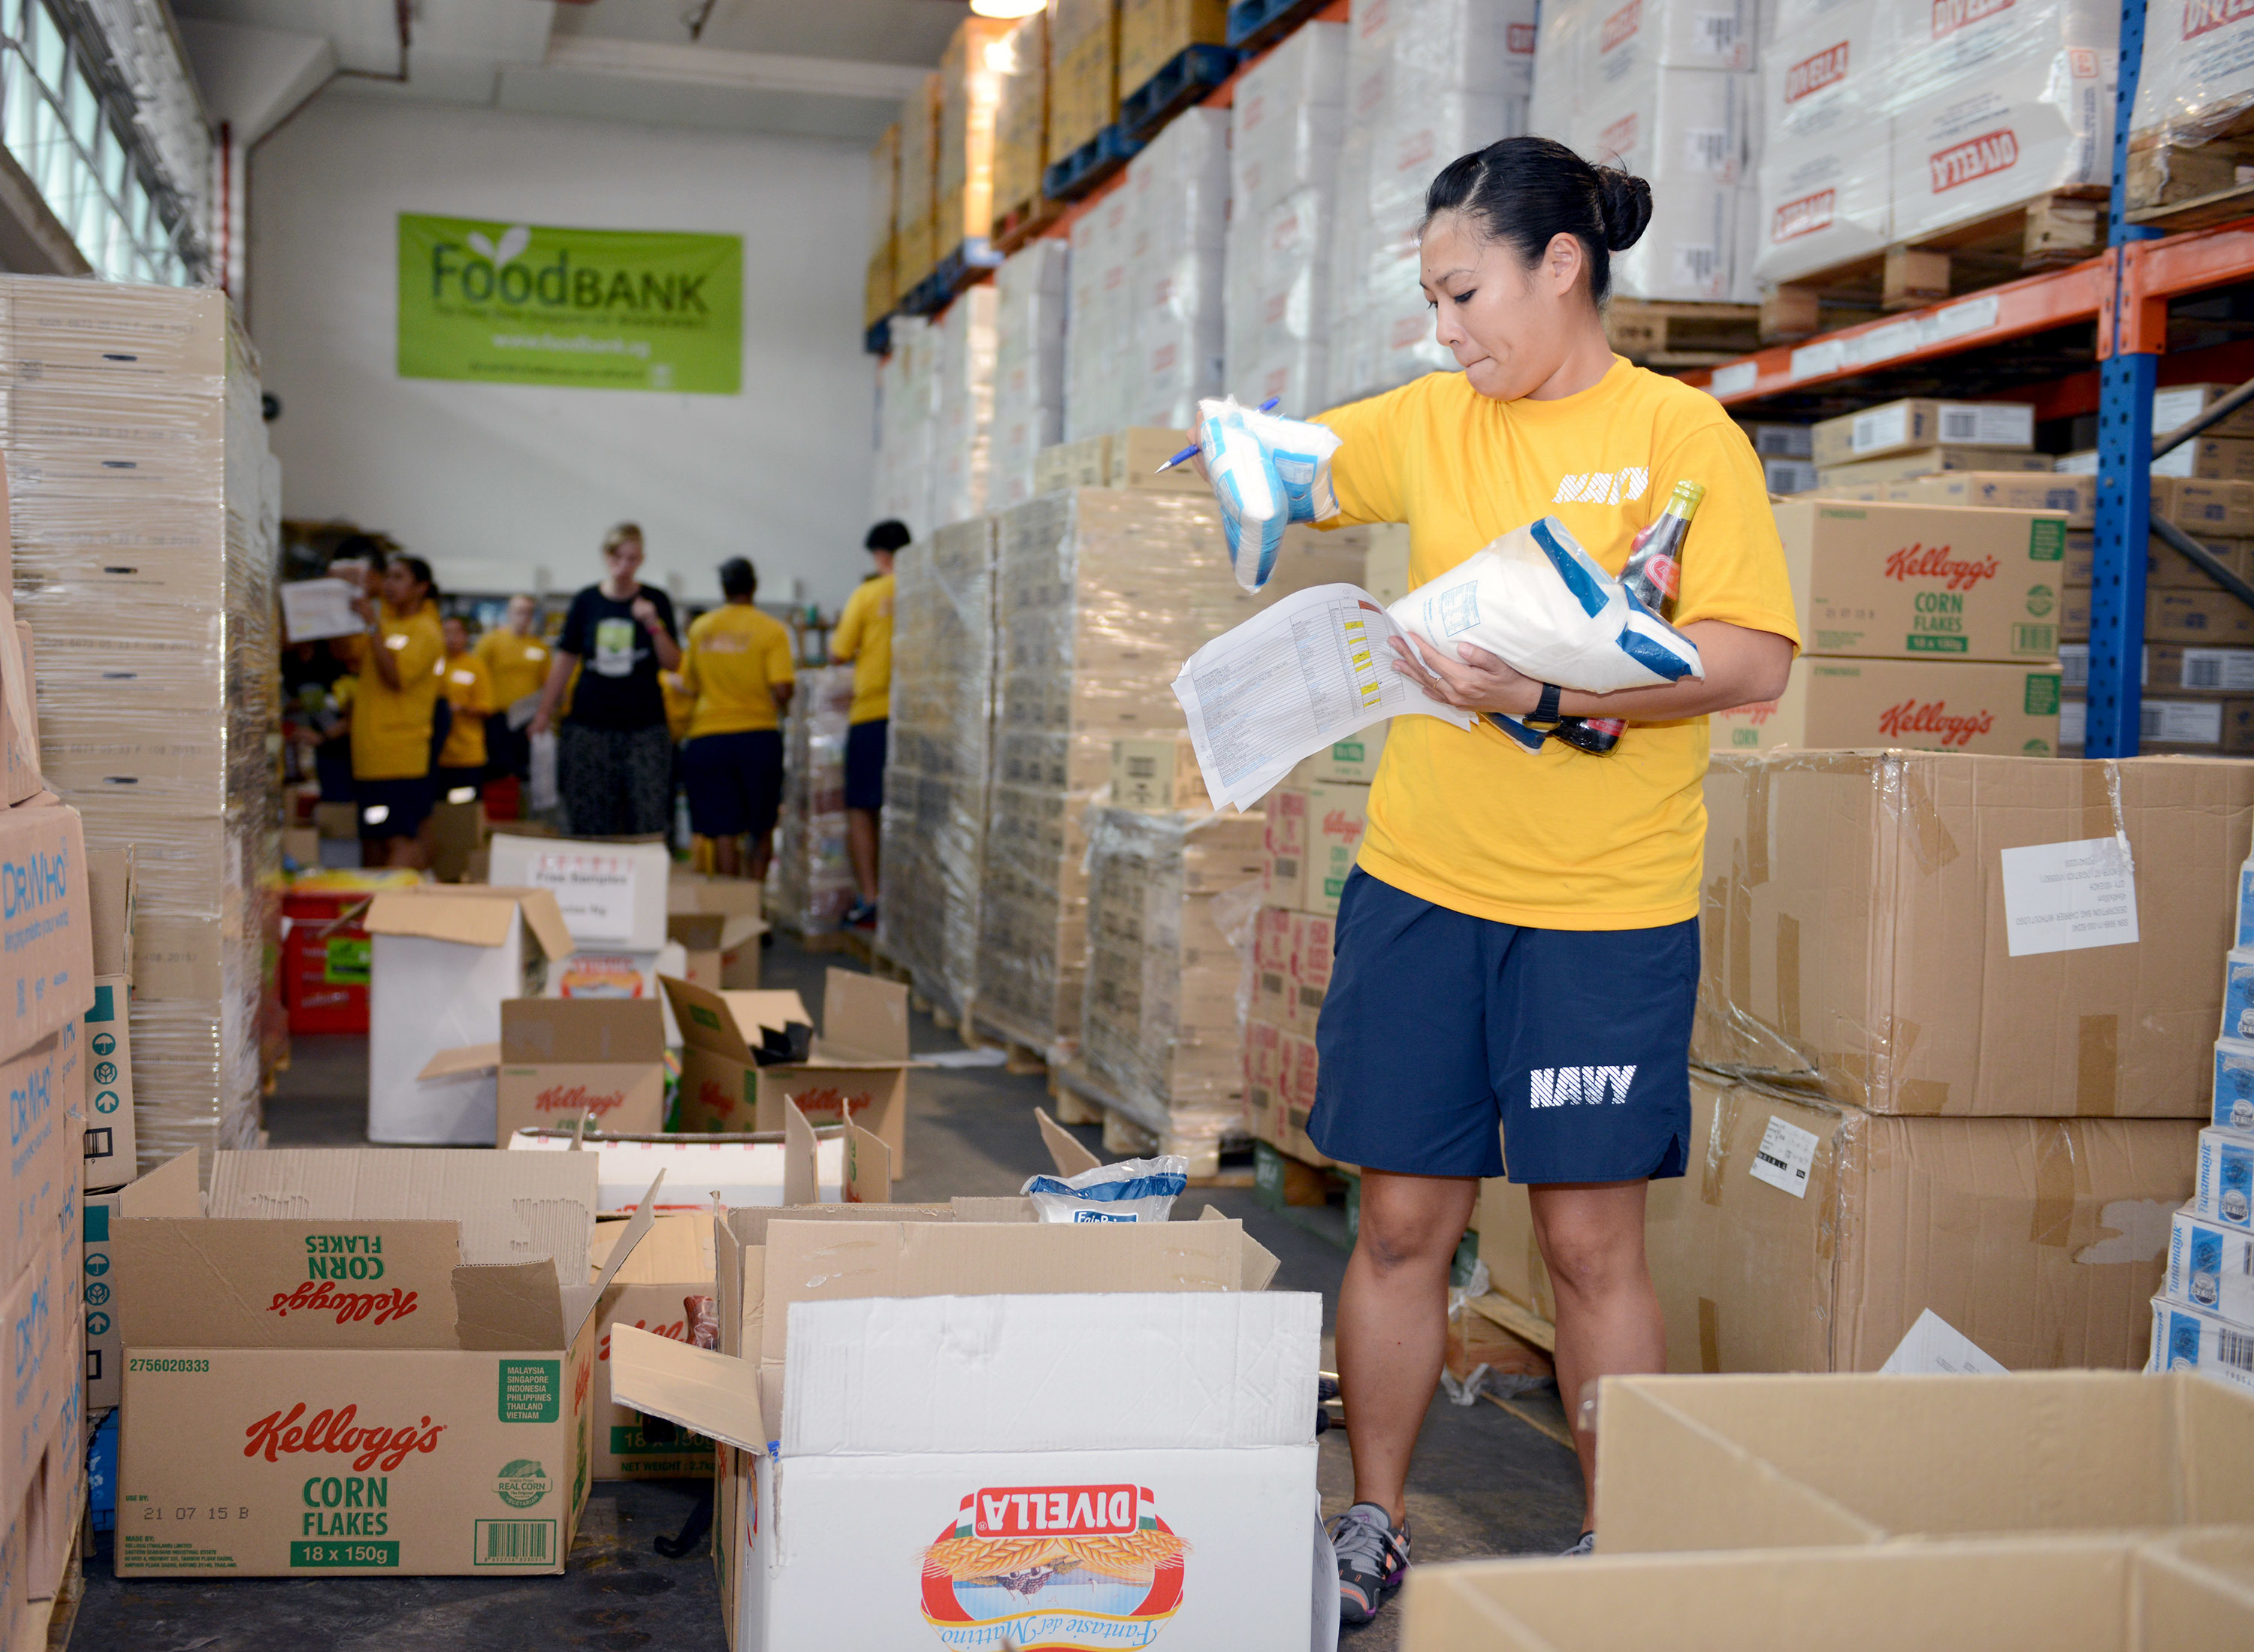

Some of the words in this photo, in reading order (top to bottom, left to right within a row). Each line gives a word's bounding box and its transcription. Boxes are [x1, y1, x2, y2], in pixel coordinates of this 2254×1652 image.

[1933, 134, 2014, 189] DIVELLA
[1552, 467, 1649, 505] NAVY
[1884, 542, 2002, 590] Kellogg's
[1914, 592, 1963, 613] CORN
[1914, 616, 1962, 632] FLAKES
[1879, 698, 1993, 745] Kellogg's
[535, 1085, 625, 1116] Kellogg's
[1530, 1065, 1637, 1109] NAVY
[2198, 1140, 2211, 1214] Tunamagik
[305, 1235, 382, 1254] FLAKES
[2169, 1224, 2182, 1294] Tunamagik
[307, 1257, 385, 1279] CORN
[269, 1281, 418, 1325] Kellogg's
[130, 1359, 210, 1373] 2756020333
[243, 1403, 443, 1472] Kellogg's
[621, 1461, 639, 1472] NET
[643, 1460, 681, 1472] WEIGHT
[302, 1477, 388, 1509] CORN
[506, 1495, 539, 1506] VEGETARIAN
[144, 1507, 162, 1520] 21
[176, 1507, 196, 1520] 07
[210, 1507, 227, 1520] 15
[239, 1507, 249, 1519] B
[302, 1512, 388, 1536] FLAKES
[982, 1491, 1132, 1530] DIVELLA
[303, 1546, 324, 1561] 18
[328, 1550, 338, 1561] x
[345, 1547, 388, 1564] 150g
[941, 1616, 1038, 1650] Mattino
[1041, 1617, 1063, 1638] del
[1065, 1620, 1158, 1647] Fantasie
